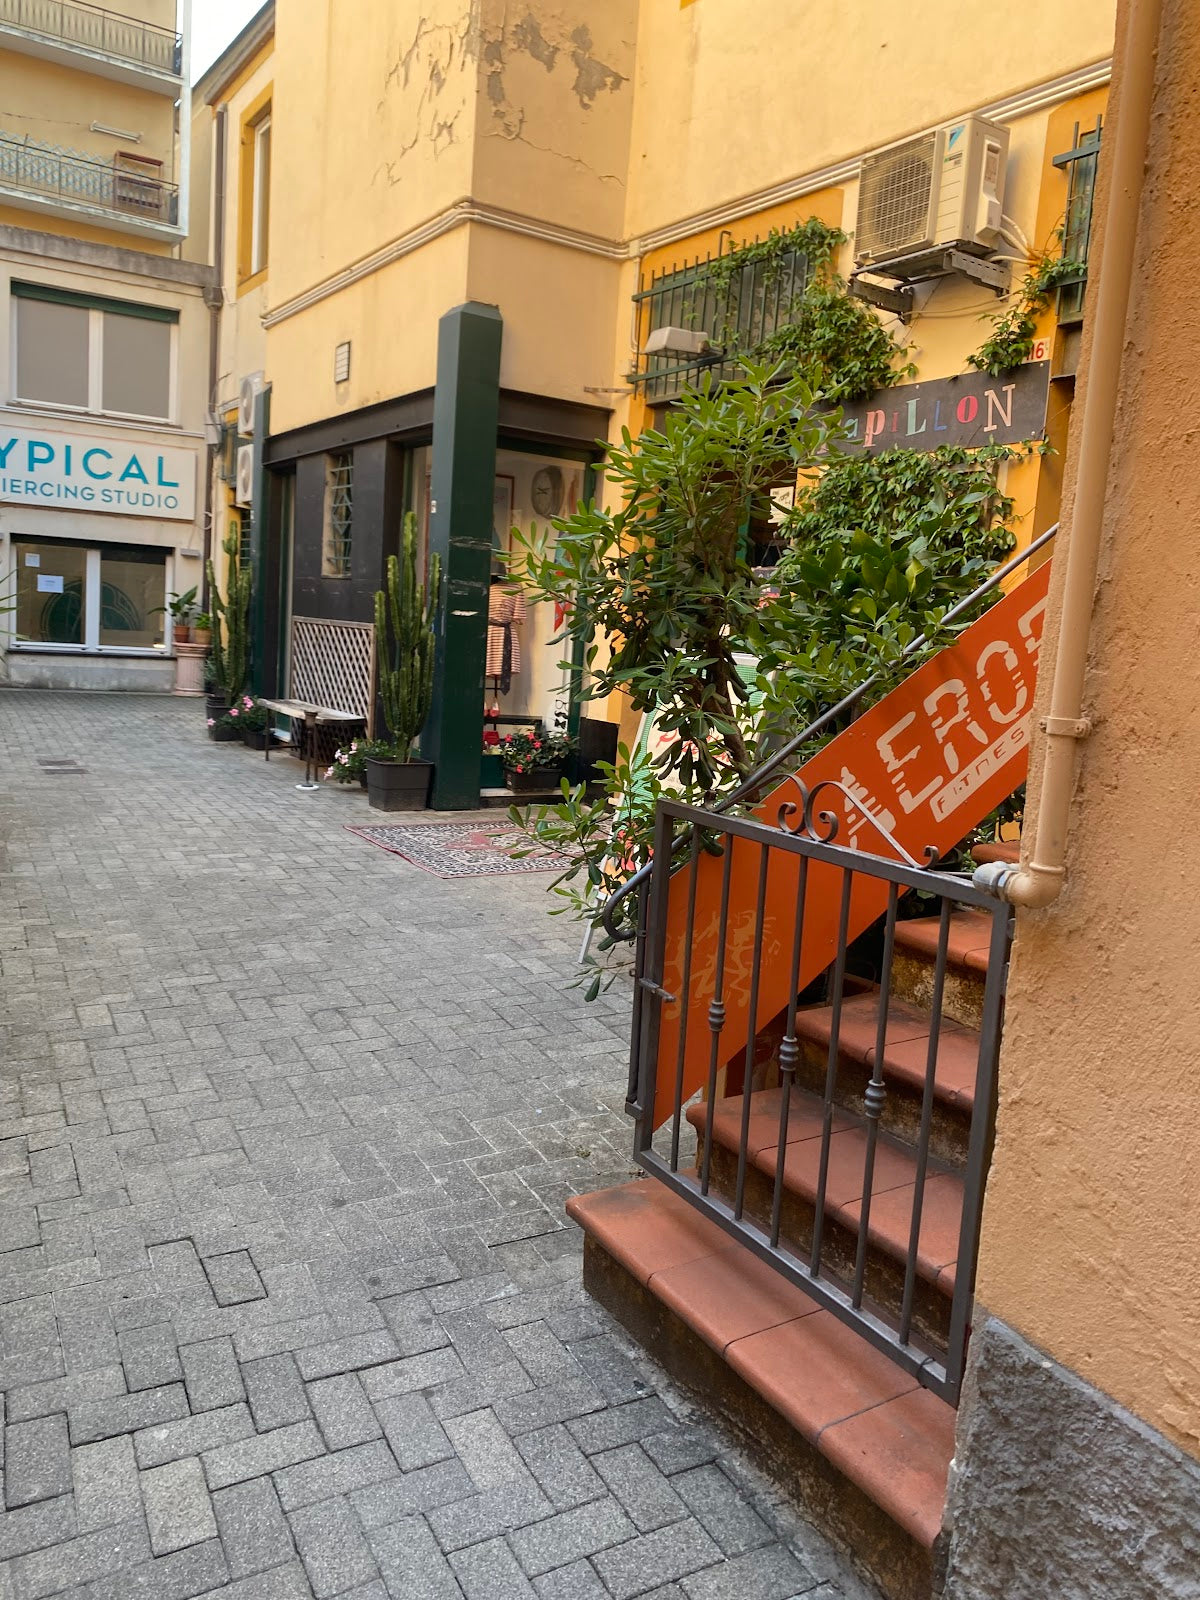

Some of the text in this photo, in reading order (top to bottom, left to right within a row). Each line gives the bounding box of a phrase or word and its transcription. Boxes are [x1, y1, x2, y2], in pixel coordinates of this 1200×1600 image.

[0, 438, 179, 488] YPICAL
[2, 478, 178, 509] IERCING STUDIO
